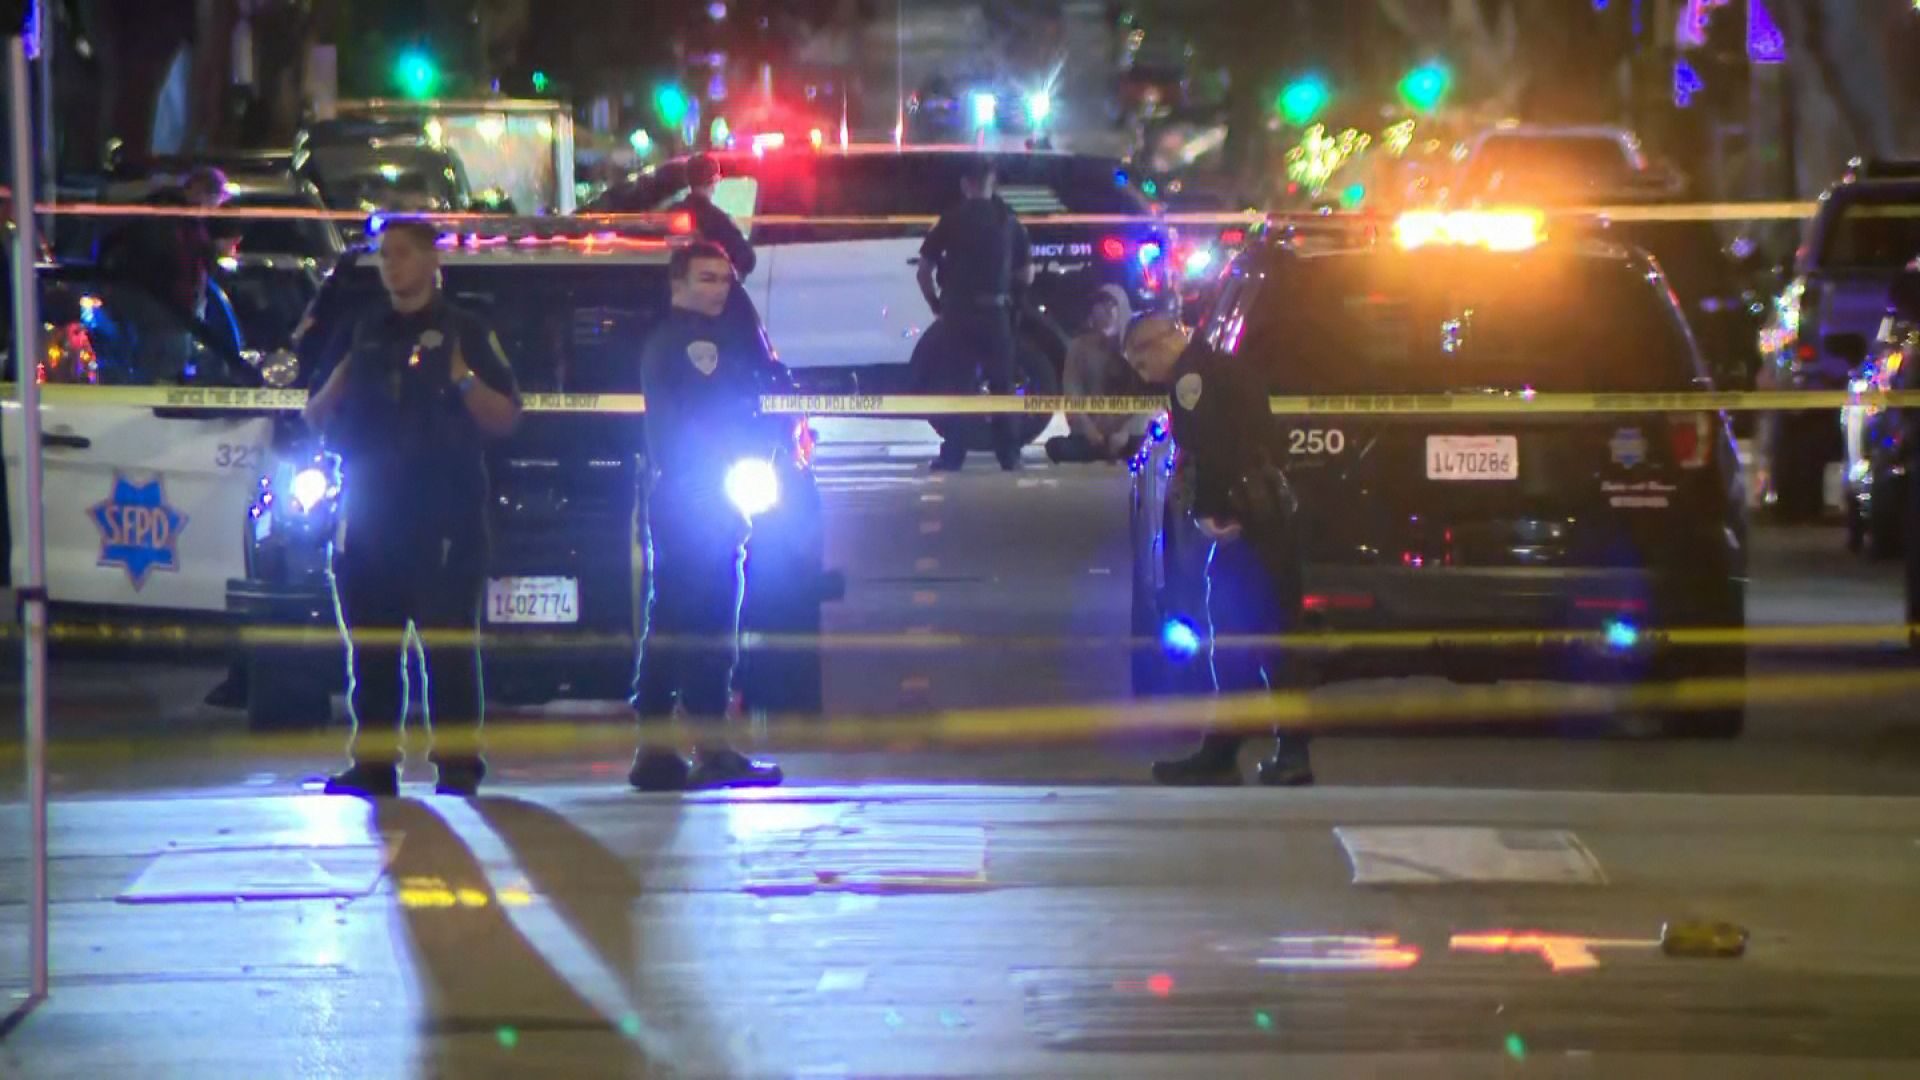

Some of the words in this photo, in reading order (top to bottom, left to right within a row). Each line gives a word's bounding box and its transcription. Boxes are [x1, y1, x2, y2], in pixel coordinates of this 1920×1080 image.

[1288, 429, 1345, 454] 250
[1433, 452, 1510, 473] 1470286
[104, 502, 169, 547] SFPD
[495, 592, 572, 616] 1402774
